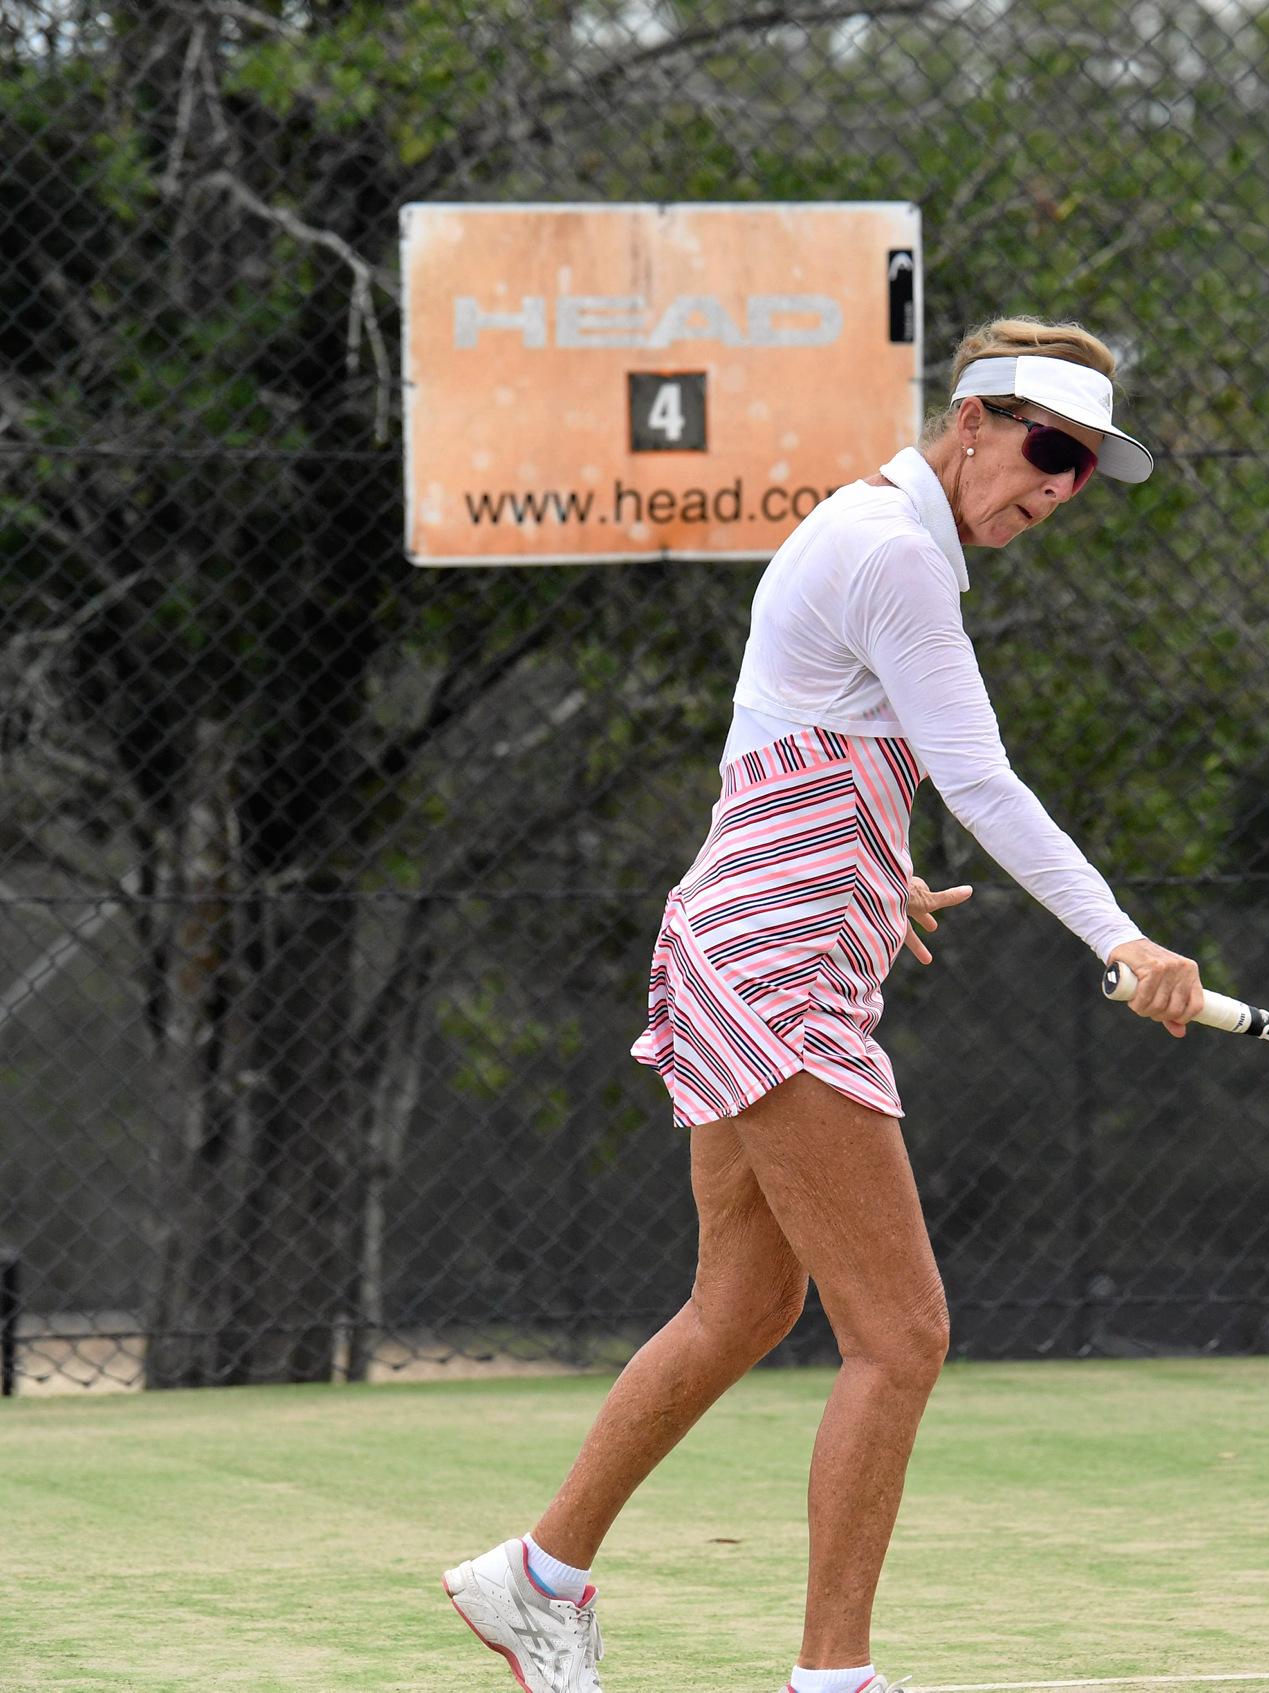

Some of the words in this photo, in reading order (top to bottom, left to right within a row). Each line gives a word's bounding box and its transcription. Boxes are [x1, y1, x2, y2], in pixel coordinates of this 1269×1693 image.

[454, 295, 843, 349] HEAD
[648, 383, 685, 441] 4
[464, 479, 838, 526] www.head.co
